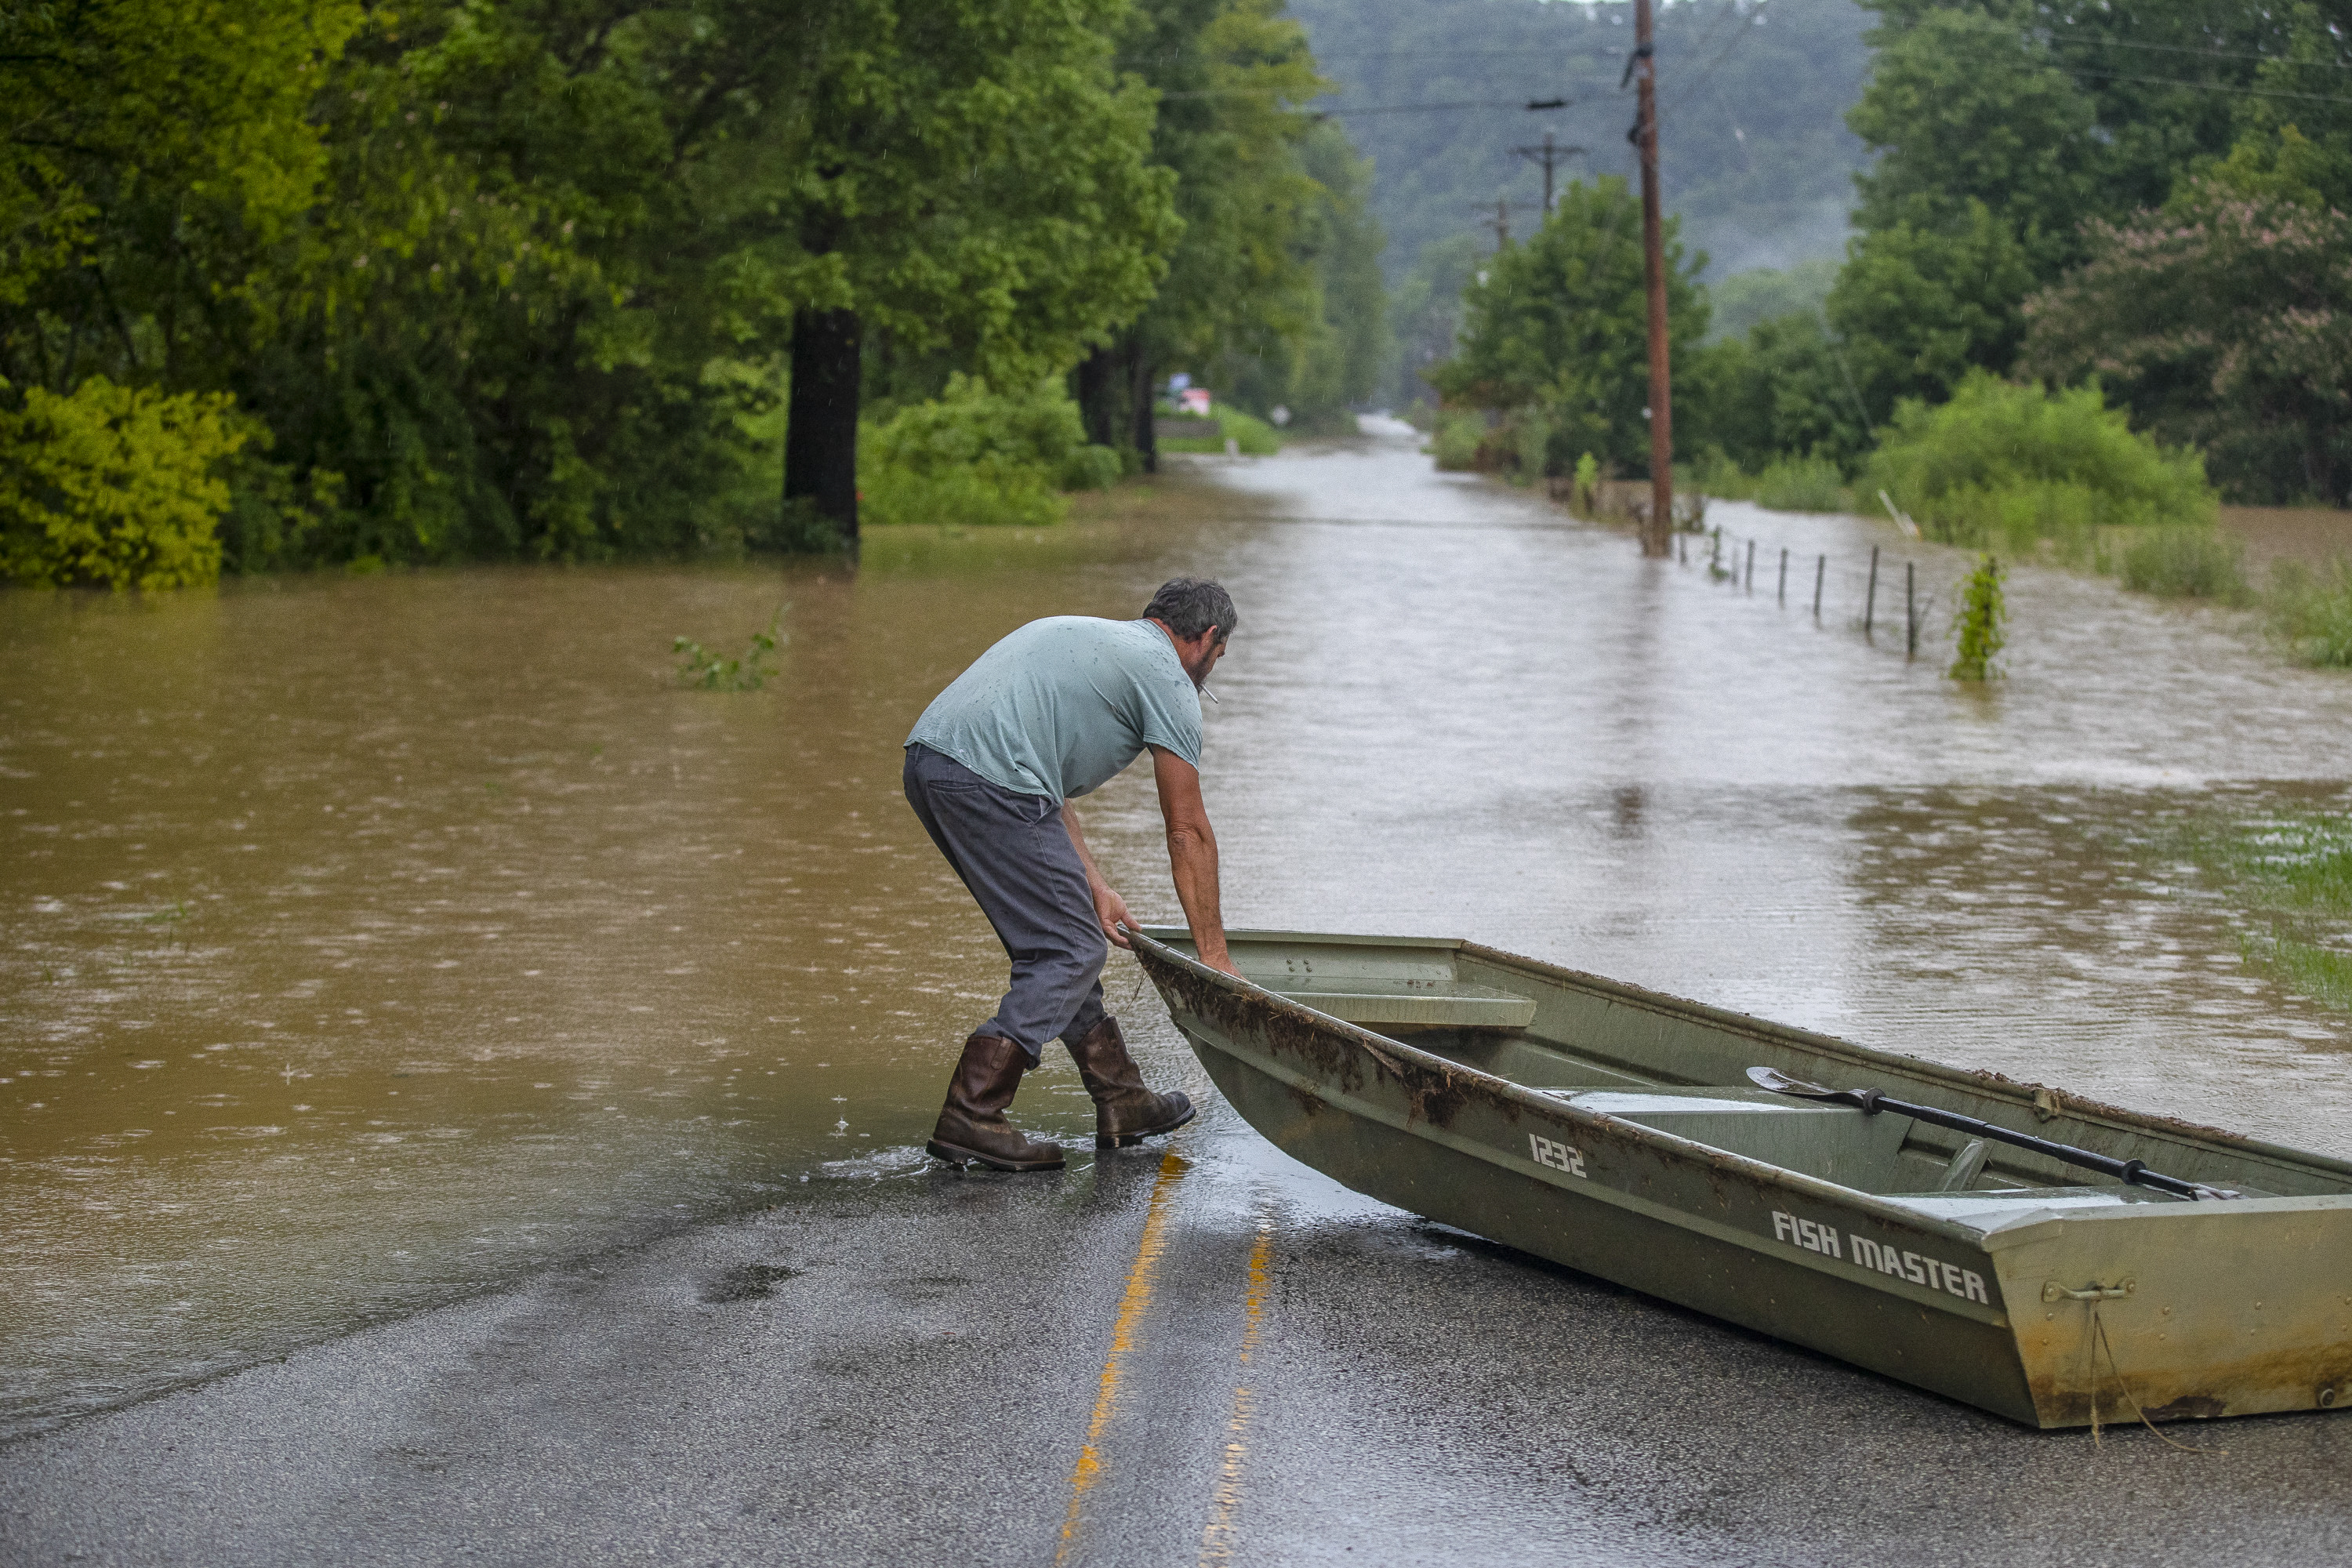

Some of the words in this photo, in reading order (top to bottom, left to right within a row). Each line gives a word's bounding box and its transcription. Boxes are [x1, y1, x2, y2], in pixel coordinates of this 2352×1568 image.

[1529, 1134, 1587, 1178] 1232
[1772, 1210, 1840, 1258] FISH
[1849, 1234, 1988, 1304] MASTER
